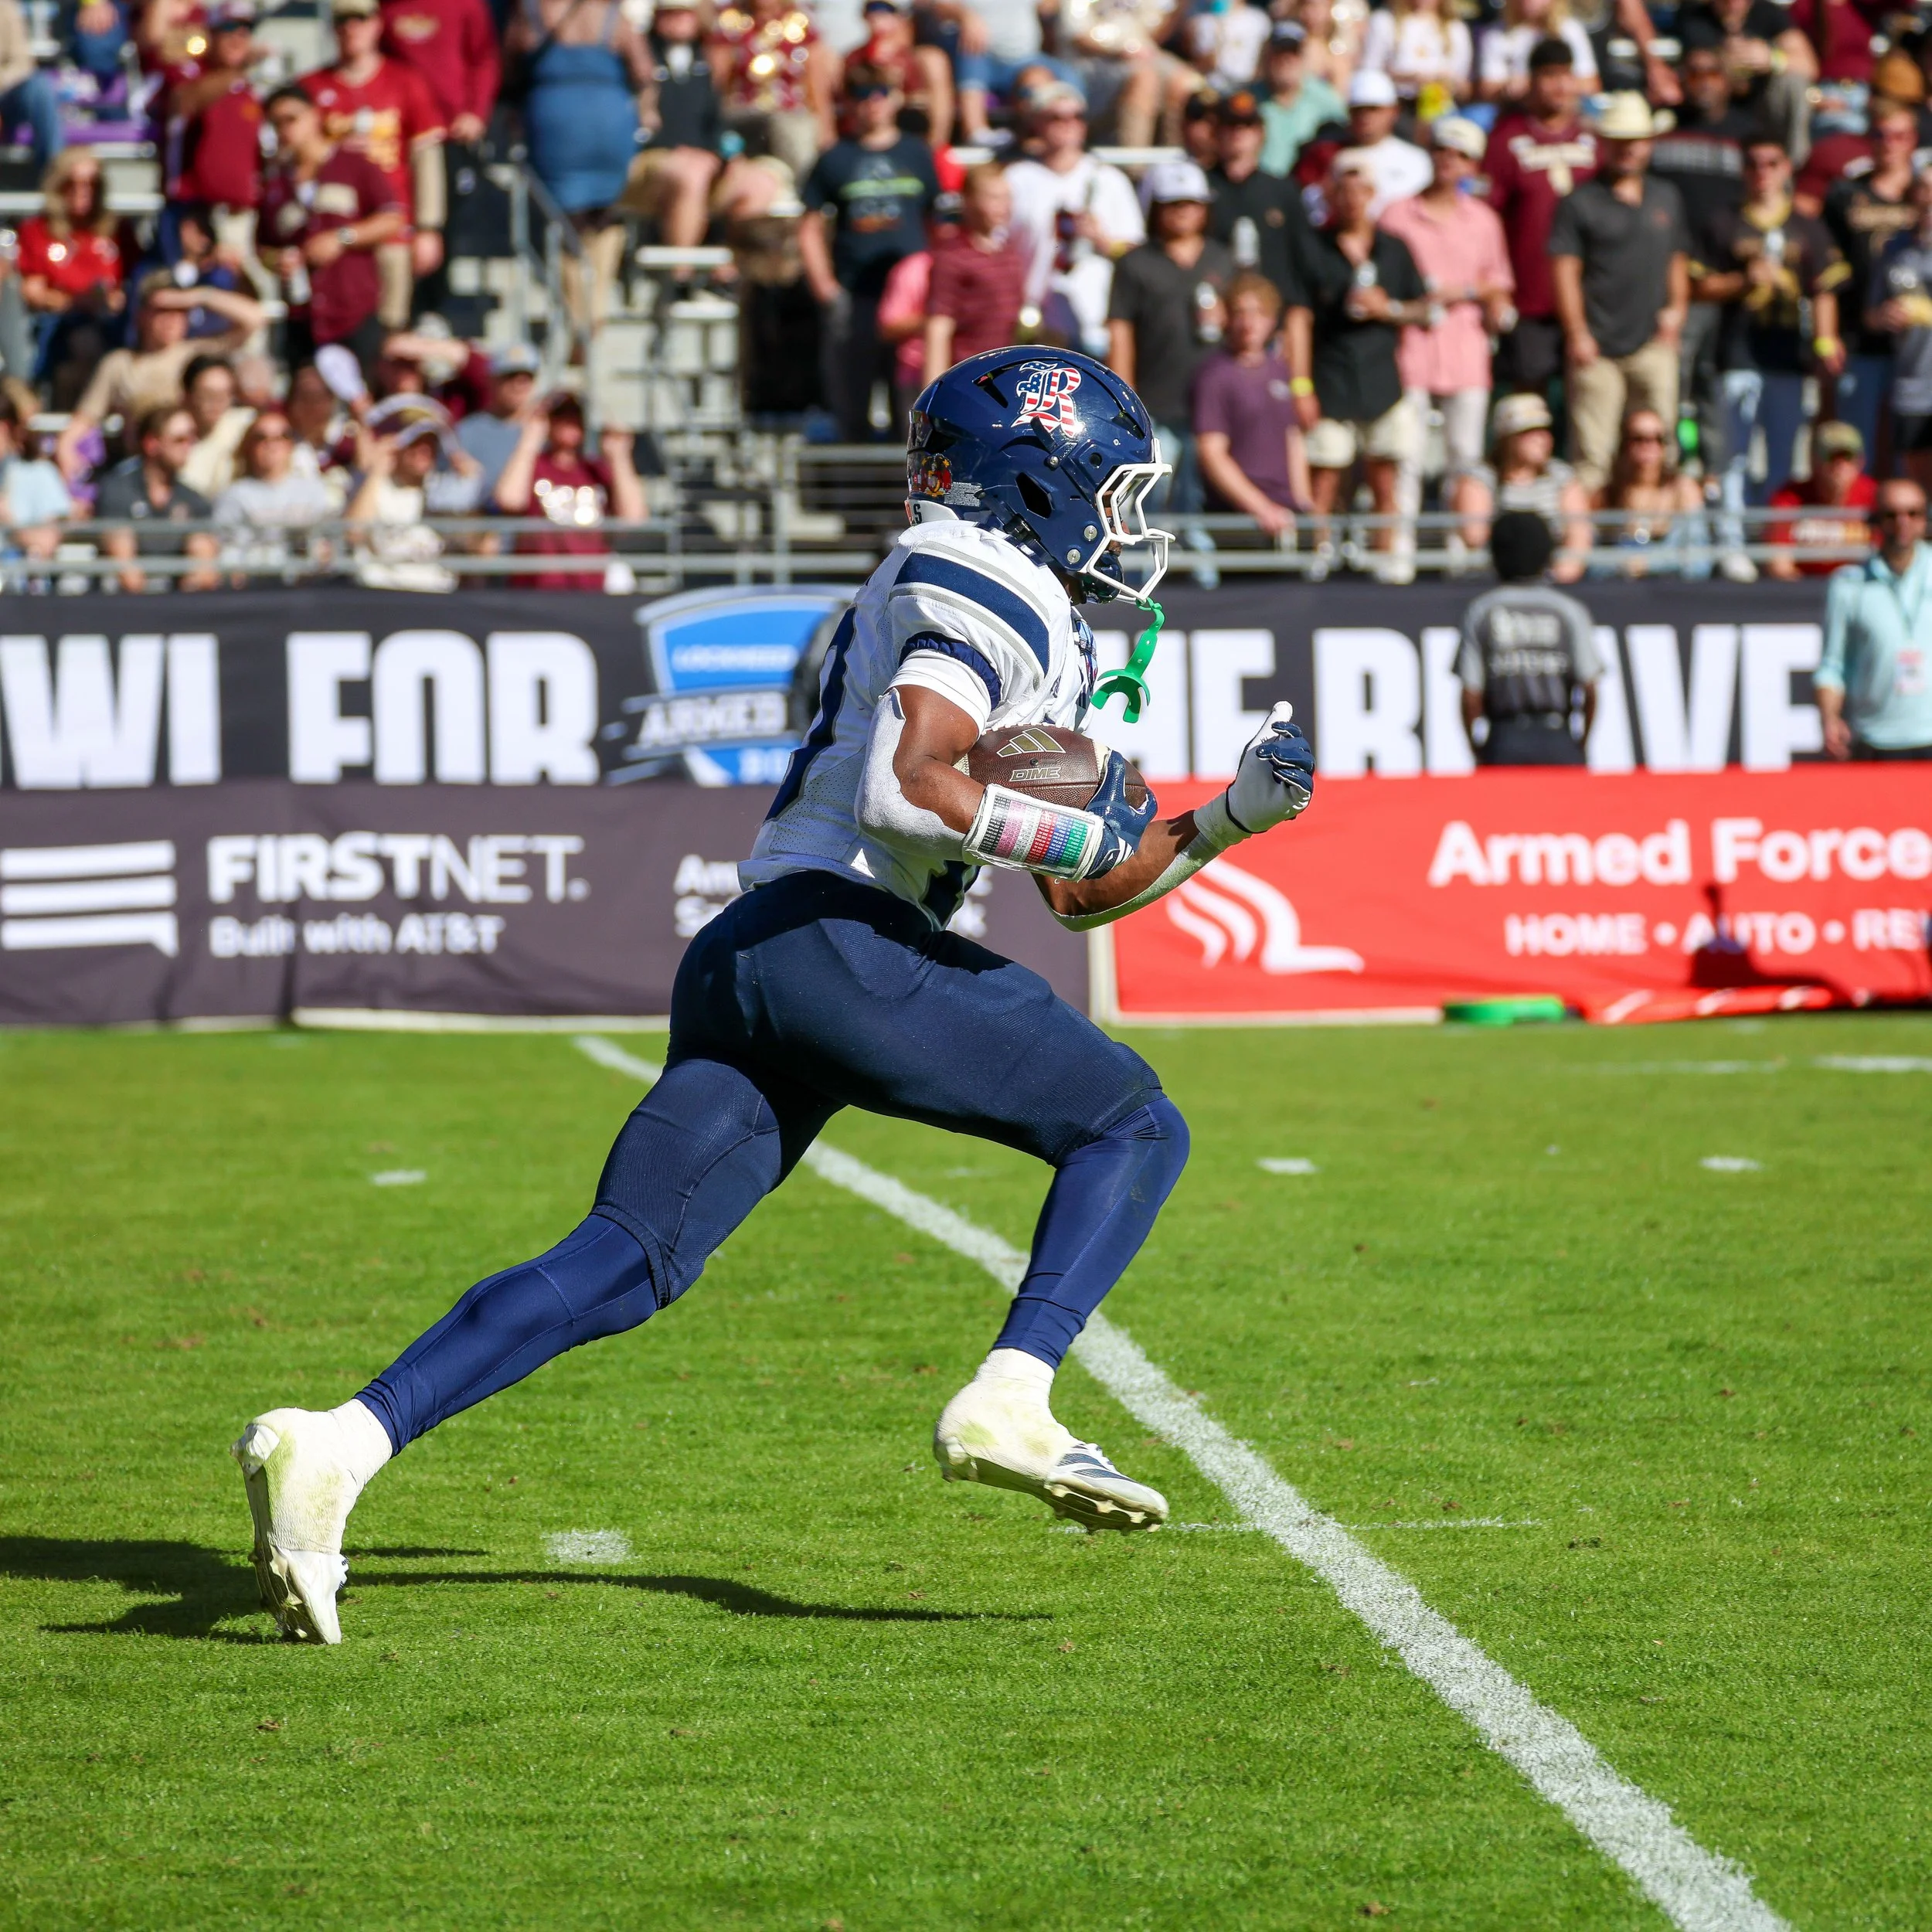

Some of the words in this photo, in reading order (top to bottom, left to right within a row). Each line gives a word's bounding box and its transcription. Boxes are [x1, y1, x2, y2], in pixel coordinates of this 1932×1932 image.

[911, 503, 923, 525] S
[286, 629, 600, 785] FOR
[1086, 629, 1277, 783] HE
[1009, 767, 1062, 782] DIME
[1427, 818, 1692, 887] Armed
[1712, 817, 1932, 883] Force
[209, 915, 296, 958] Built
[304, 911, 392, 955] with
[396, 912, 506, 955] AT&T
[1504, 913, 1649, 956] HOME
[1681, 910, 1817, 955] AUTO
